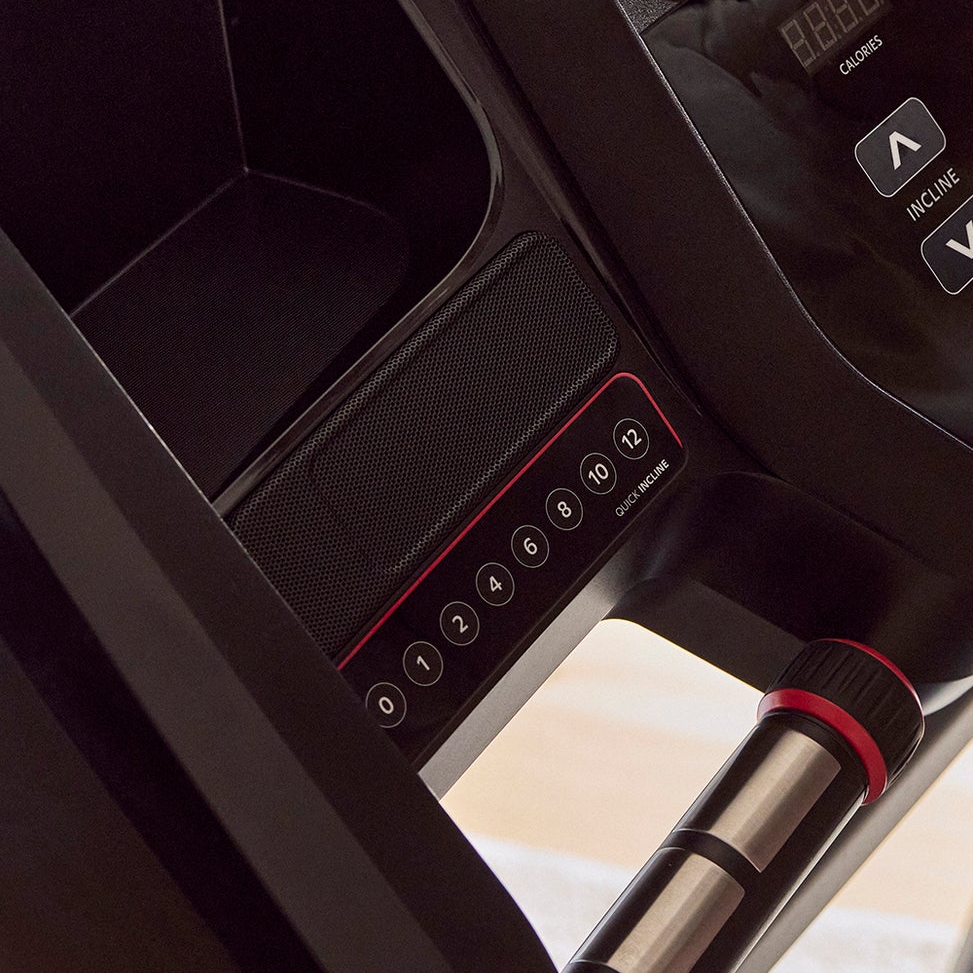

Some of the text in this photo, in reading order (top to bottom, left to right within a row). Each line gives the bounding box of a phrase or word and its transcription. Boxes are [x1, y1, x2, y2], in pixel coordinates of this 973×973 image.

[839, 35, 883, 76] CALORIES
[907, 168, 961, 221] INCLINE
[622, 429, 642, 450] 12
[588, 463, 610, 485] 10
[615, 458, 670, 517] QUICK INCLINE
[557, 501, 572, 518] 8
[523, 538, 538, 555] 6
[488, 576, 503, 593] 4
[452, 615, 469, 633] 2
[417, 656, 431, 672] 1
[378, 697, 395, 715] 0
